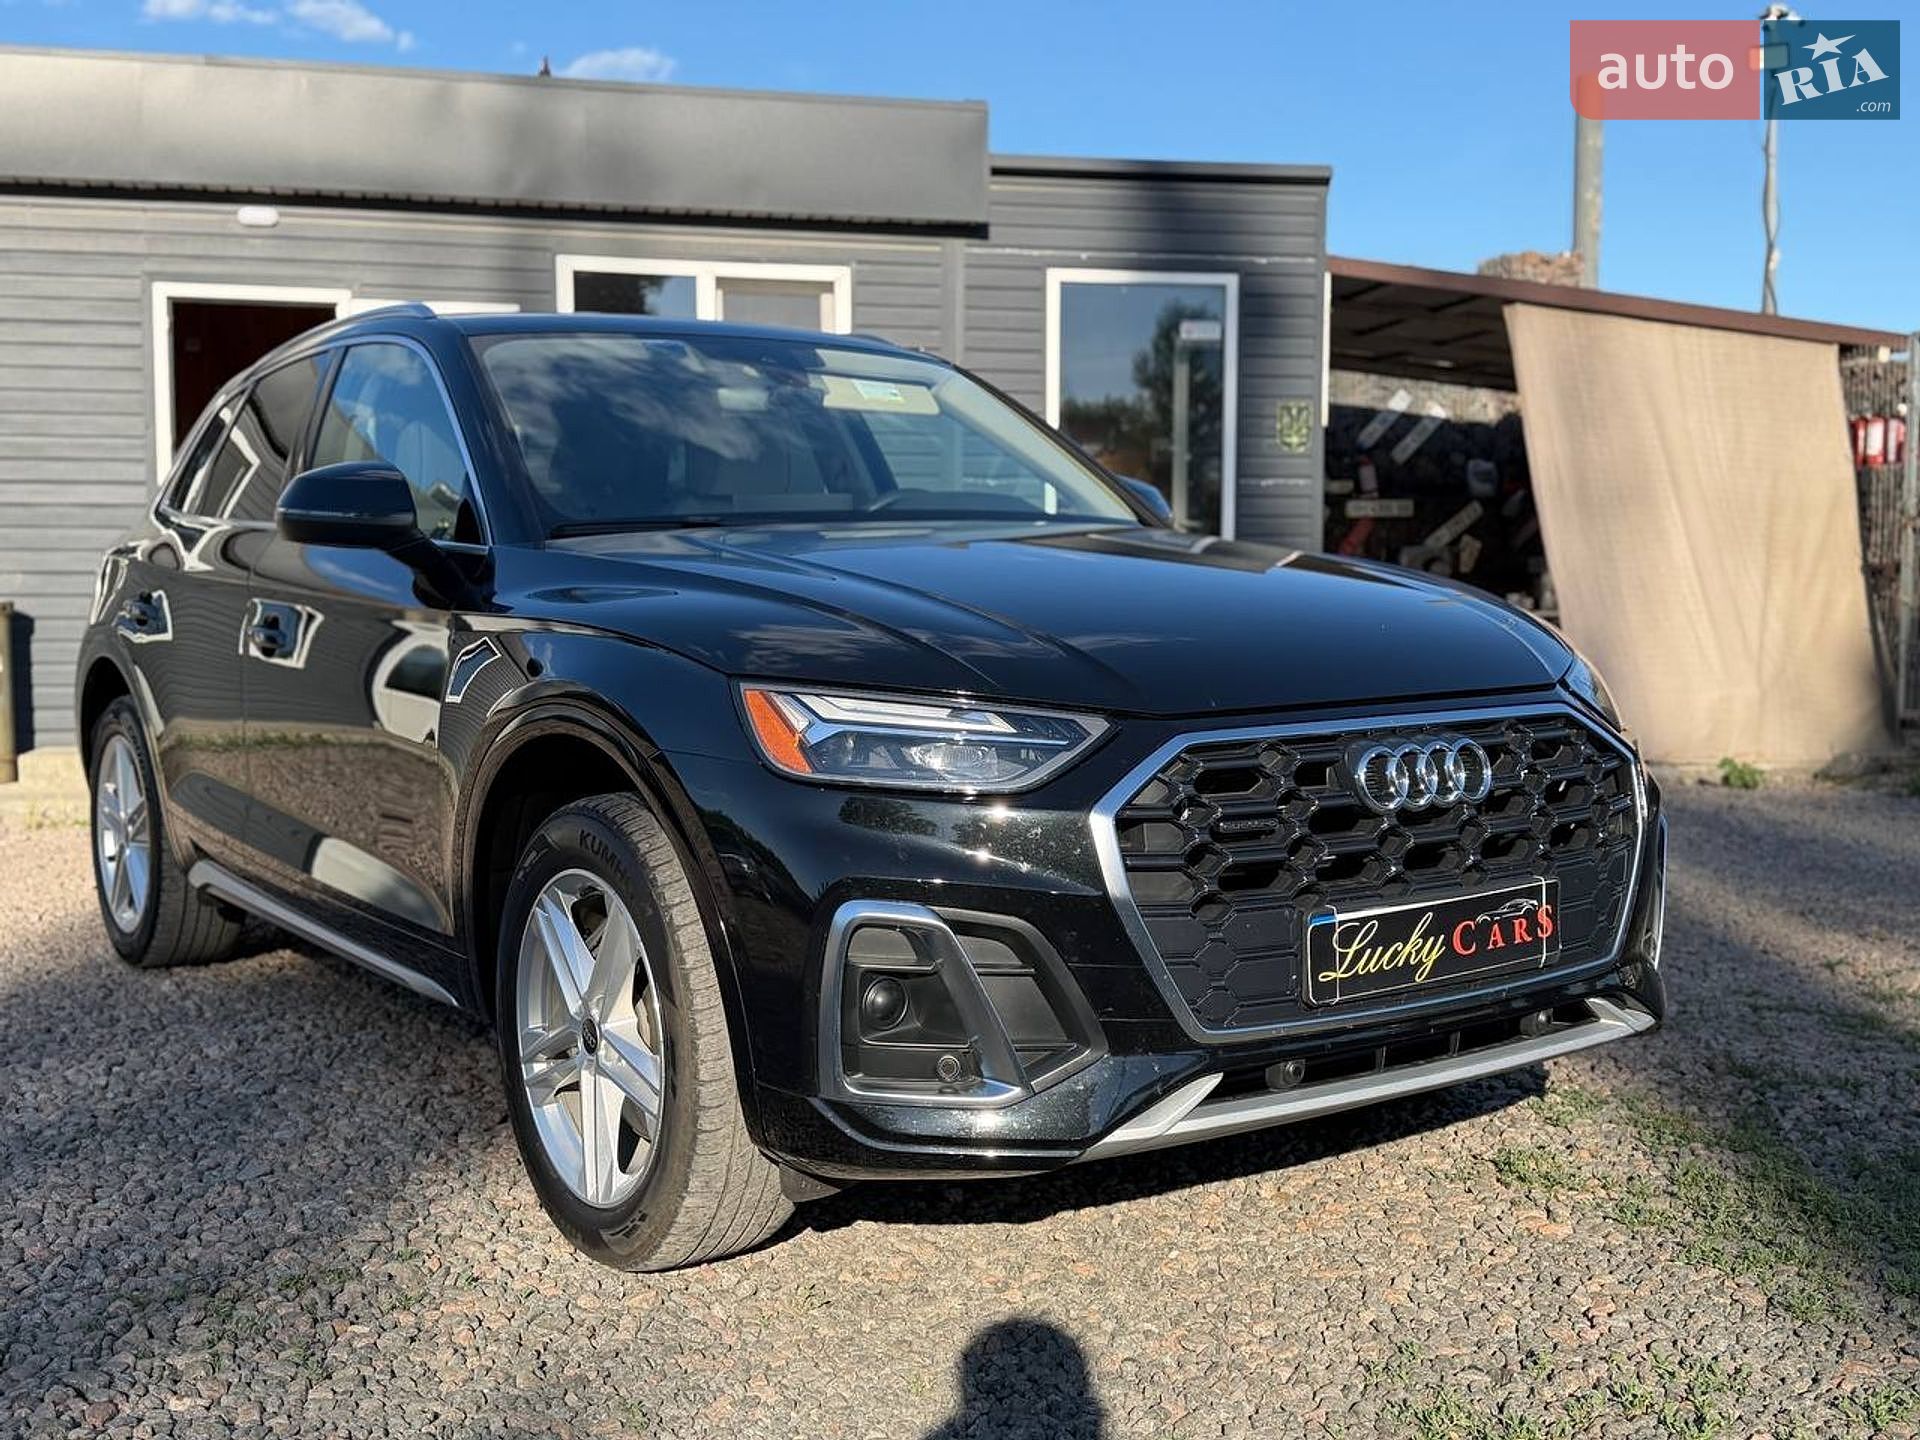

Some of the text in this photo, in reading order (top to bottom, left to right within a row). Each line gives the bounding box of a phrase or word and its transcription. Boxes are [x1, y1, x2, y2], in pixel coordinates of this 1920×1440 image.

[578, 828, 629, 880] KUM
[1318, 904, 1553, 983] Lucky CARS
